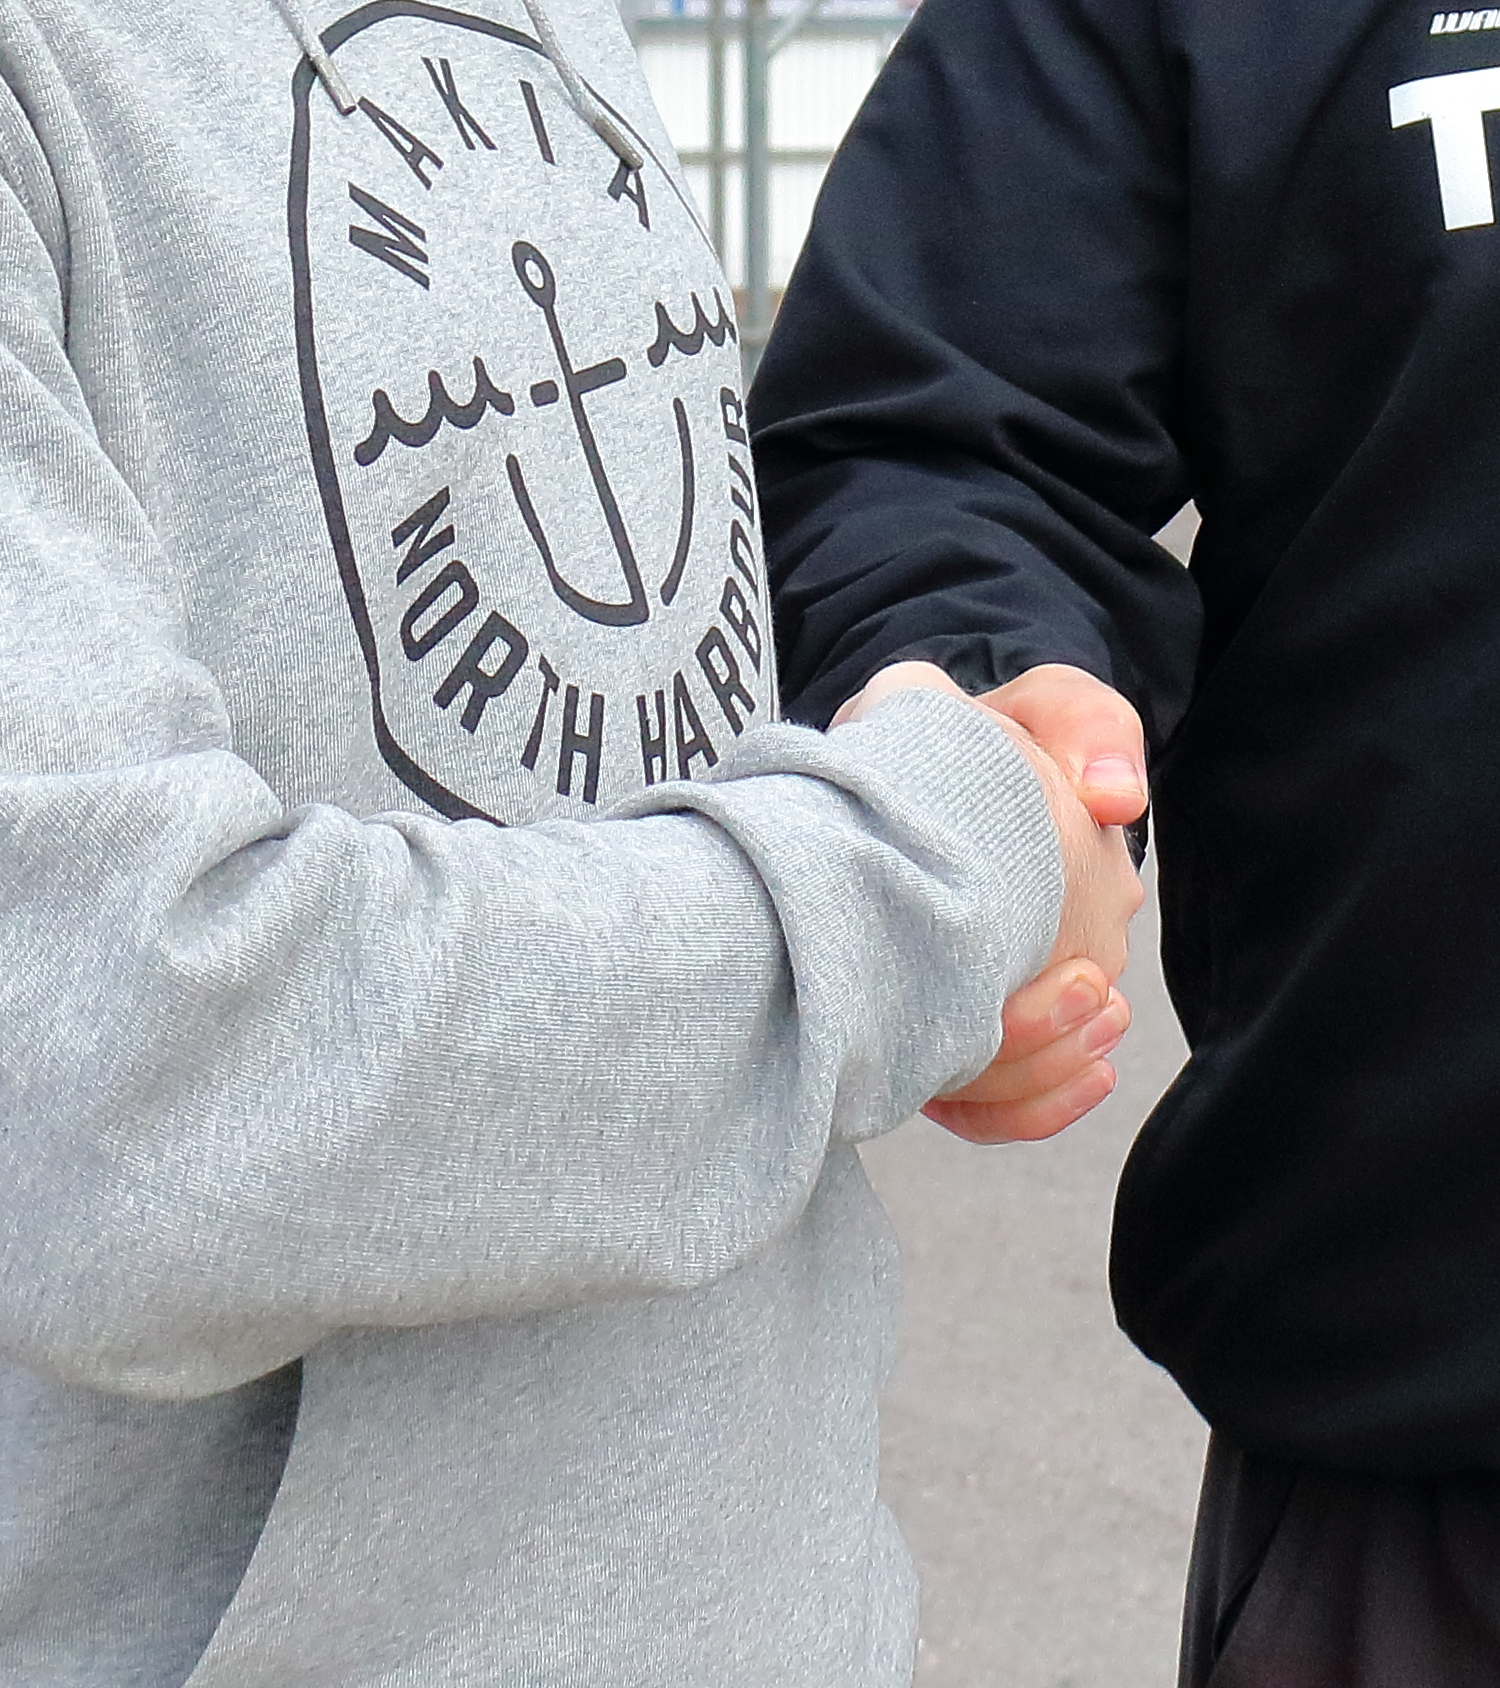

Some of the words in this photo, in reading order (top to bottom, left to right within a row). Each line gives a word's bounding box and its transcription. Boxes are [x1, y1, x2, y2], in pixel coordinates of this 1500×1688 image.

[349, 56, 651, 290] MAKIA
[392, 486, 604, 804] NORTH
[637, 386, 761, 786] HARBOUR
